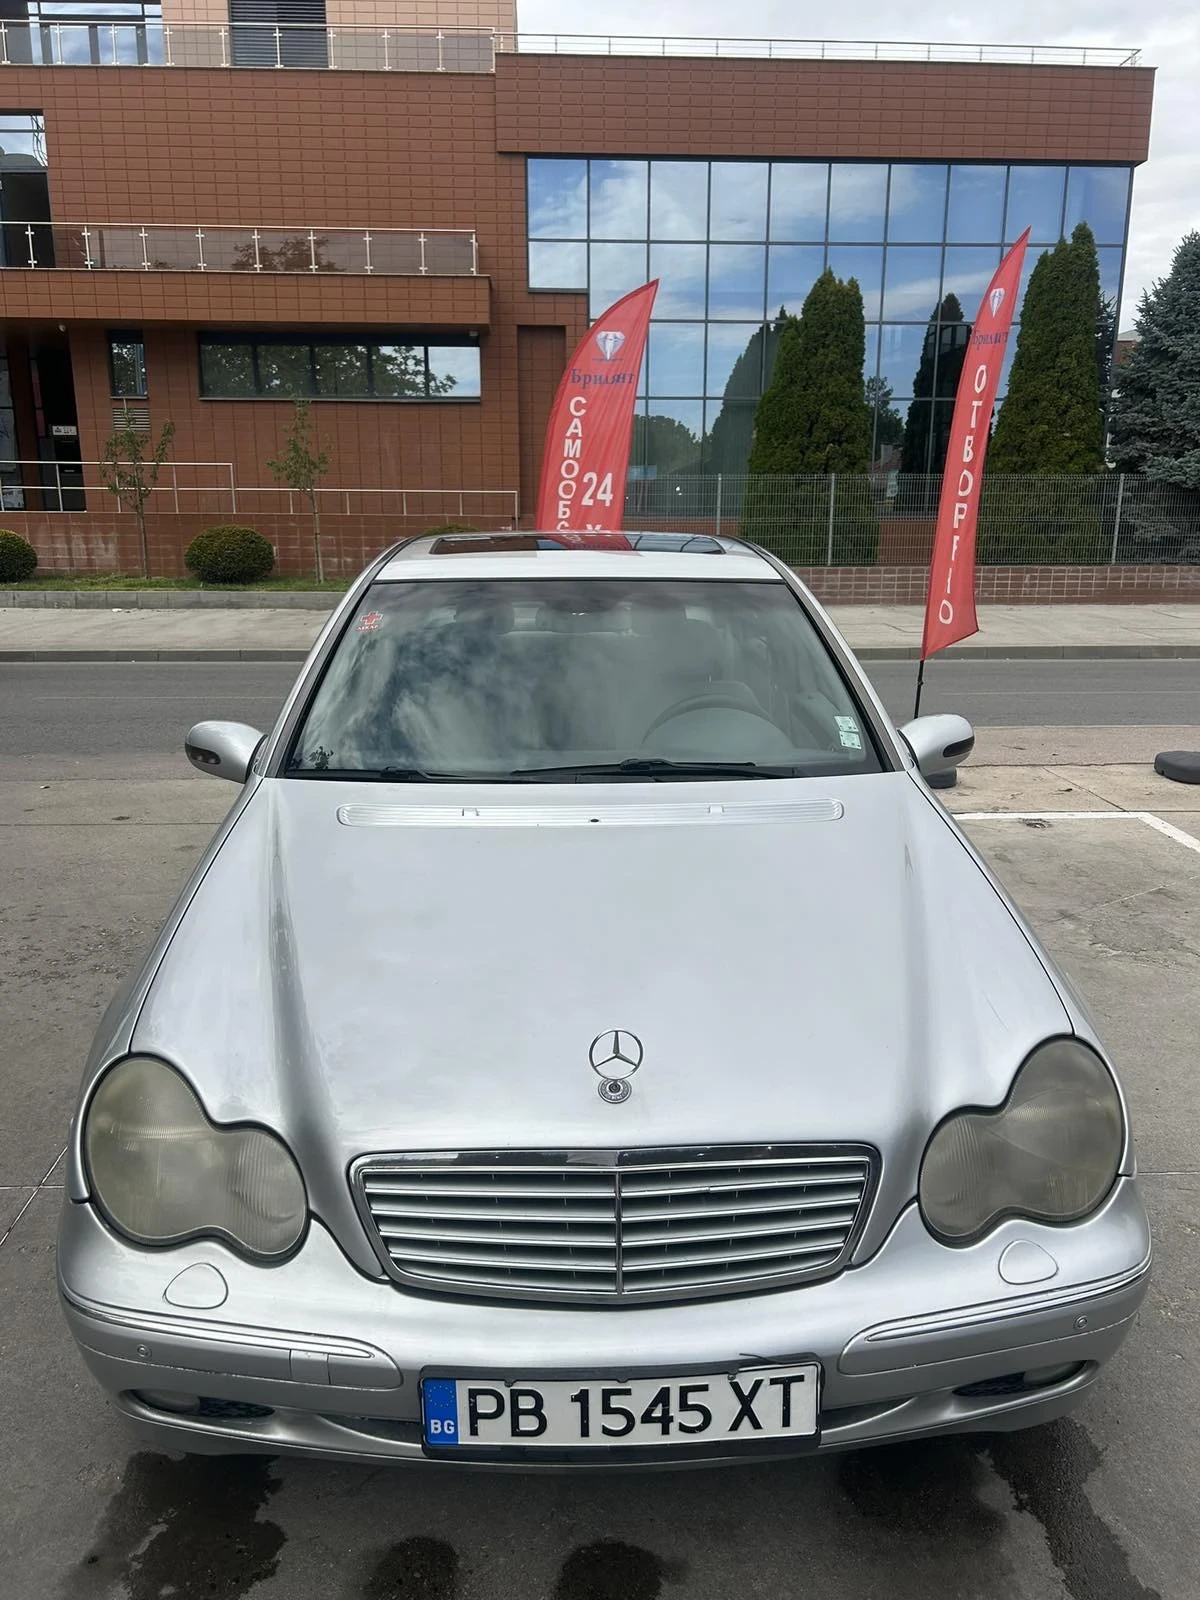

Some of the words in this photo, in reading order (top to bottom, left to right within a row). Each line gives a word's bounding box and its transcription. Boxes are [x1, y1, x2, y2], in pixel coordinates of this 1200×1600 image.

[581, 471, 614, 507] 24
[468, 1388, 548, 1437] PB
[571, 1383, 712, 1437] 1545
[728, 1374, 805, 1432] XT
[430, 1419, 455, 1434] BG
